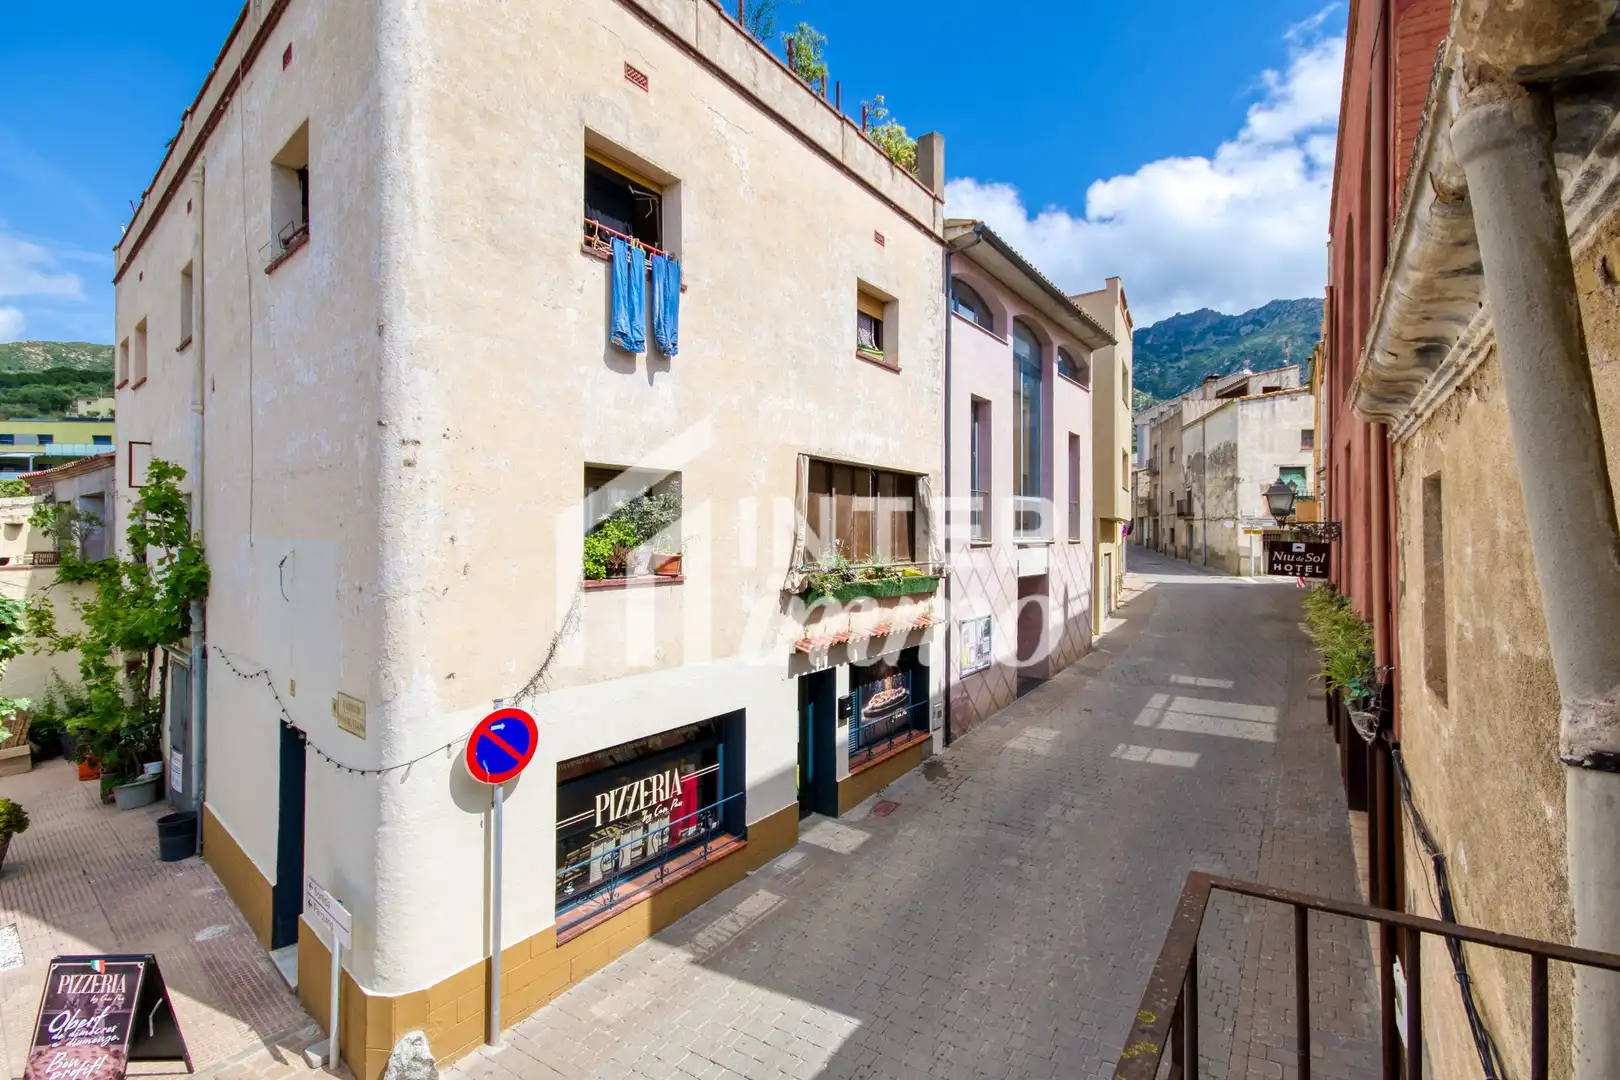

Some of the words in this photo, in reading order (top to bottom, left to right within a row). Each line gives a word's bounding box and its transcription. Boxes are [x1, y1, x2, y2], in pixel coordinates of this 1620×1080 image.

[1272, 551, 1295, 562] Niu
[1305, 552, 1326, 563] Sol
[1273, 563, 1323, 574] HOTEL
[594, 768, 683, 828] PIZZERIA
[57, 973, 127, 994] PIZZERIA
[48, 1005, 110, 1034] Obert
[45, 1051, 80, 1074] Bon
